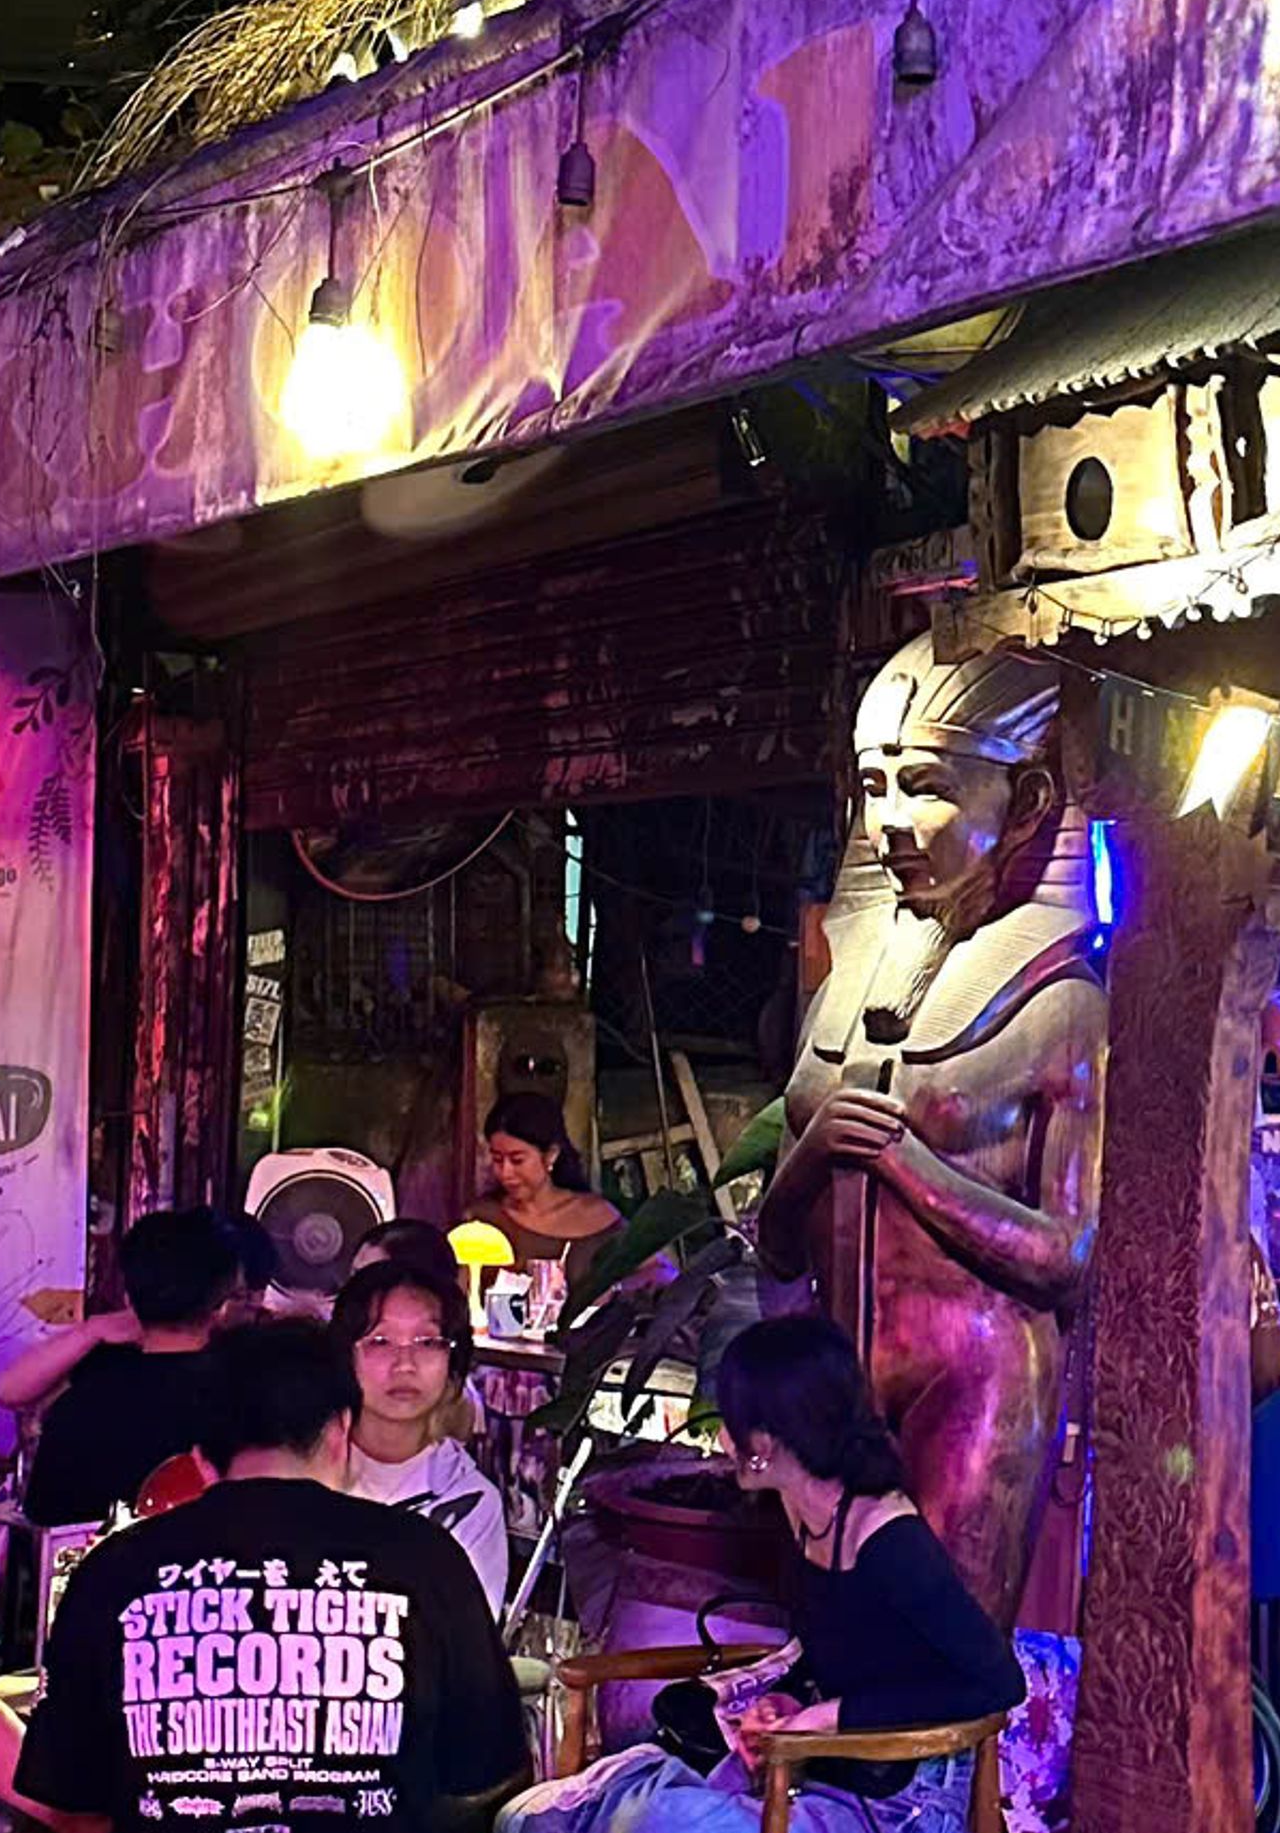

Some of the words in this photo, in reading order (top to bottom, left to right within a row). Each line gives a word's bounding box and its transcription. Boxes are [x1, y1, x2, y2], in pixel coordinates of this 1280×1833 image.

[119, 1588, 256, 1640] STICK
[264, 1588, 410, 1637] TIGHT
[122, 1632, 406, 1702] RECORDS
[123, 1701, 165, 1758] THE
[167, 1698, 320, 1756] SOUTHEAST
[324, 1700, 404, 1756] ASIAN
[237, 1768, 289, 1783] BAND
[293, 1769, 381, 1783] PROGRAM
[263, 1755, 313, 1770] SPLIT
